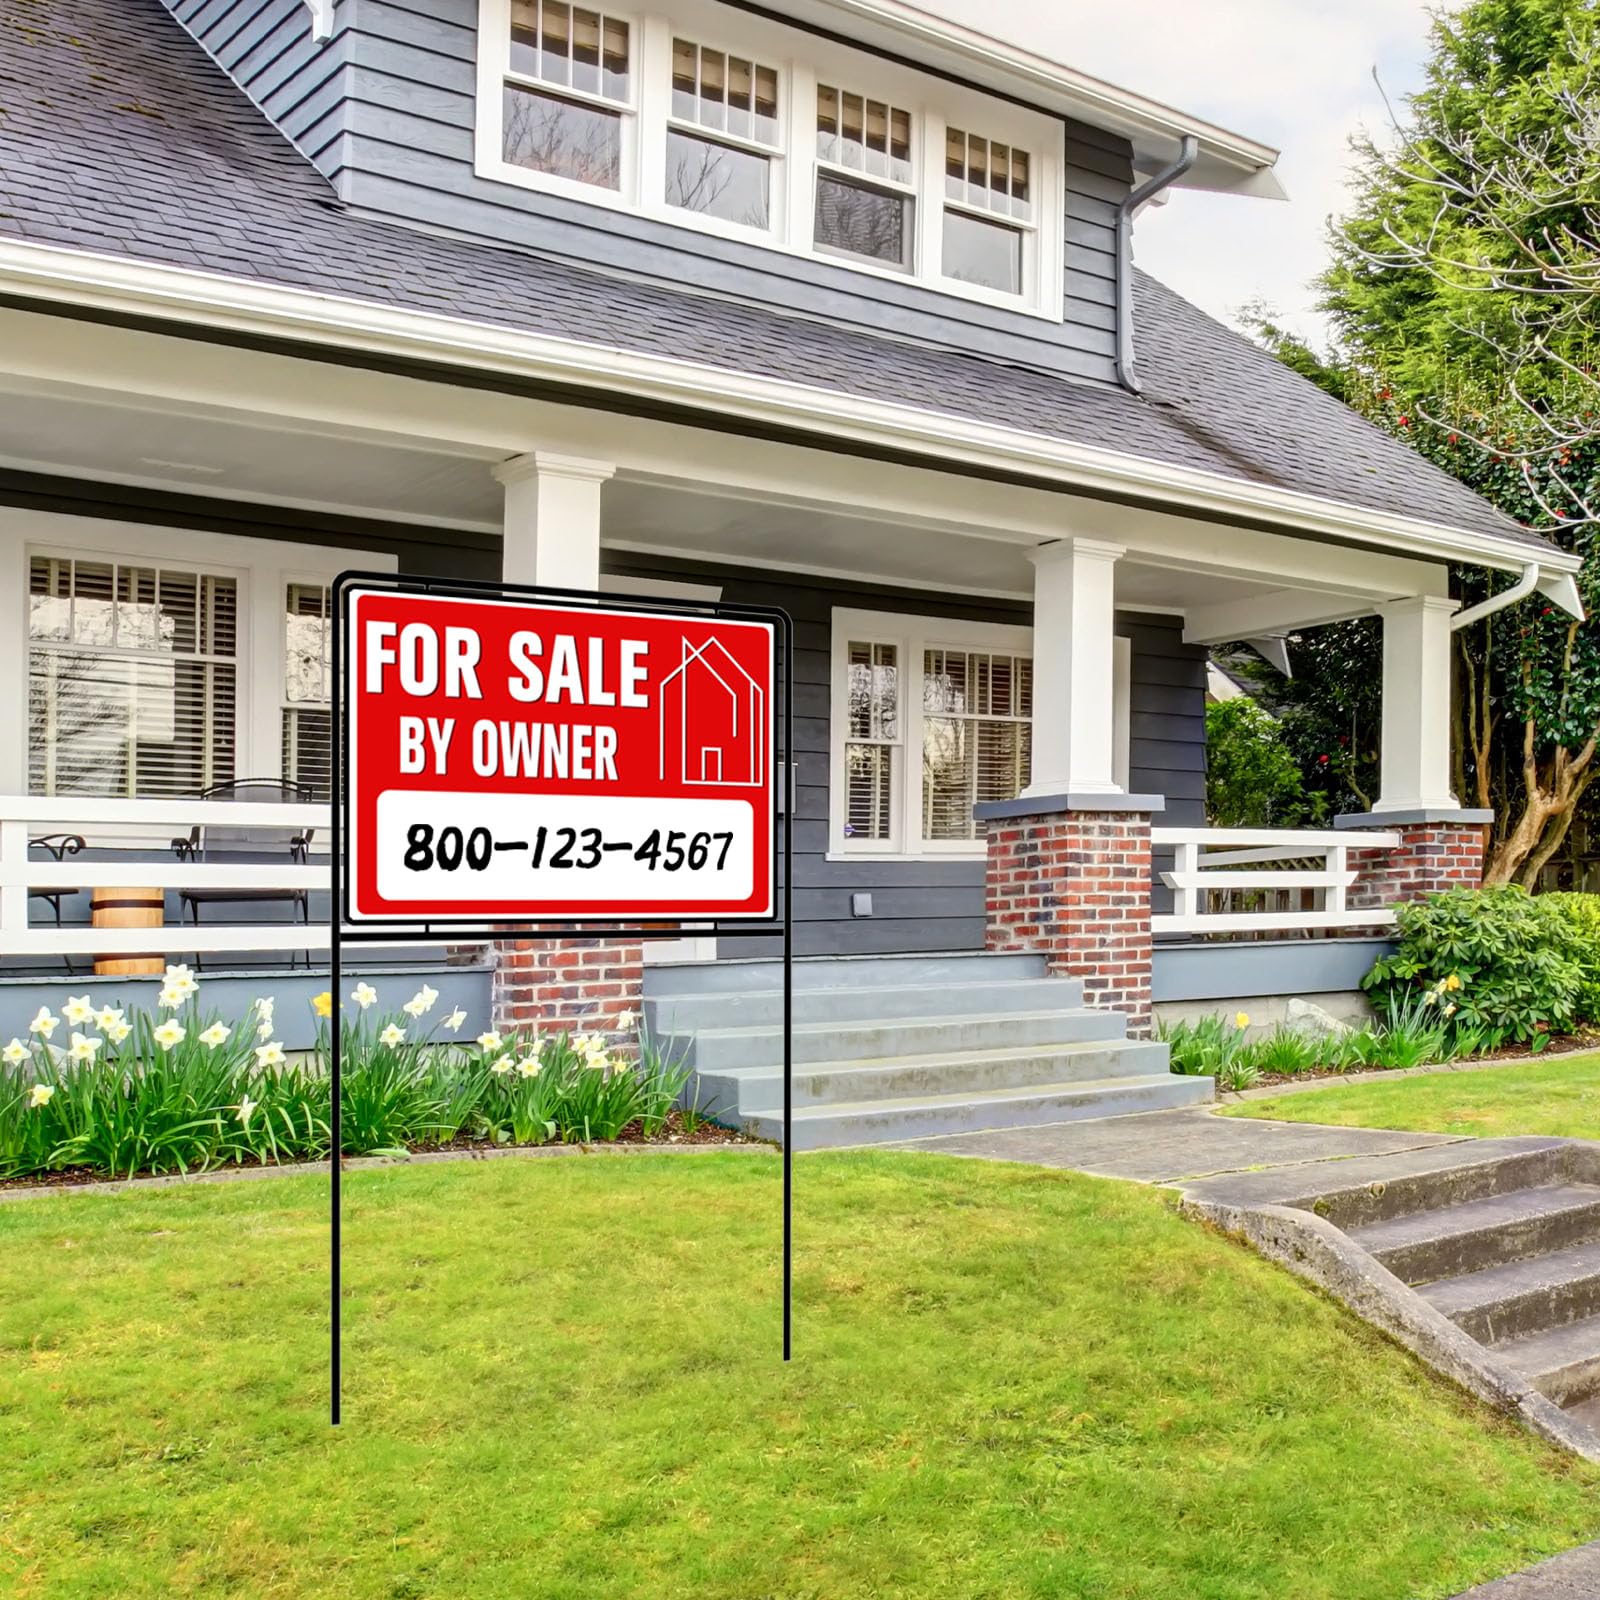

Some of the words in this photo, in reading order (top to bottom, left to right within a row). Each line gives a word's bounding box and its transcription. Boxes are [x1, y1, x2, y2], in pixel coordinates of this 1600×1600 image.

[366, 620, 483, 699] FOR
[508, 630, 649, 708] SALE
[399, 716, 455, 775] BY
[472, 719, 618, 781] OWNER
[403, 823, 734, 872] 800-123-4567
